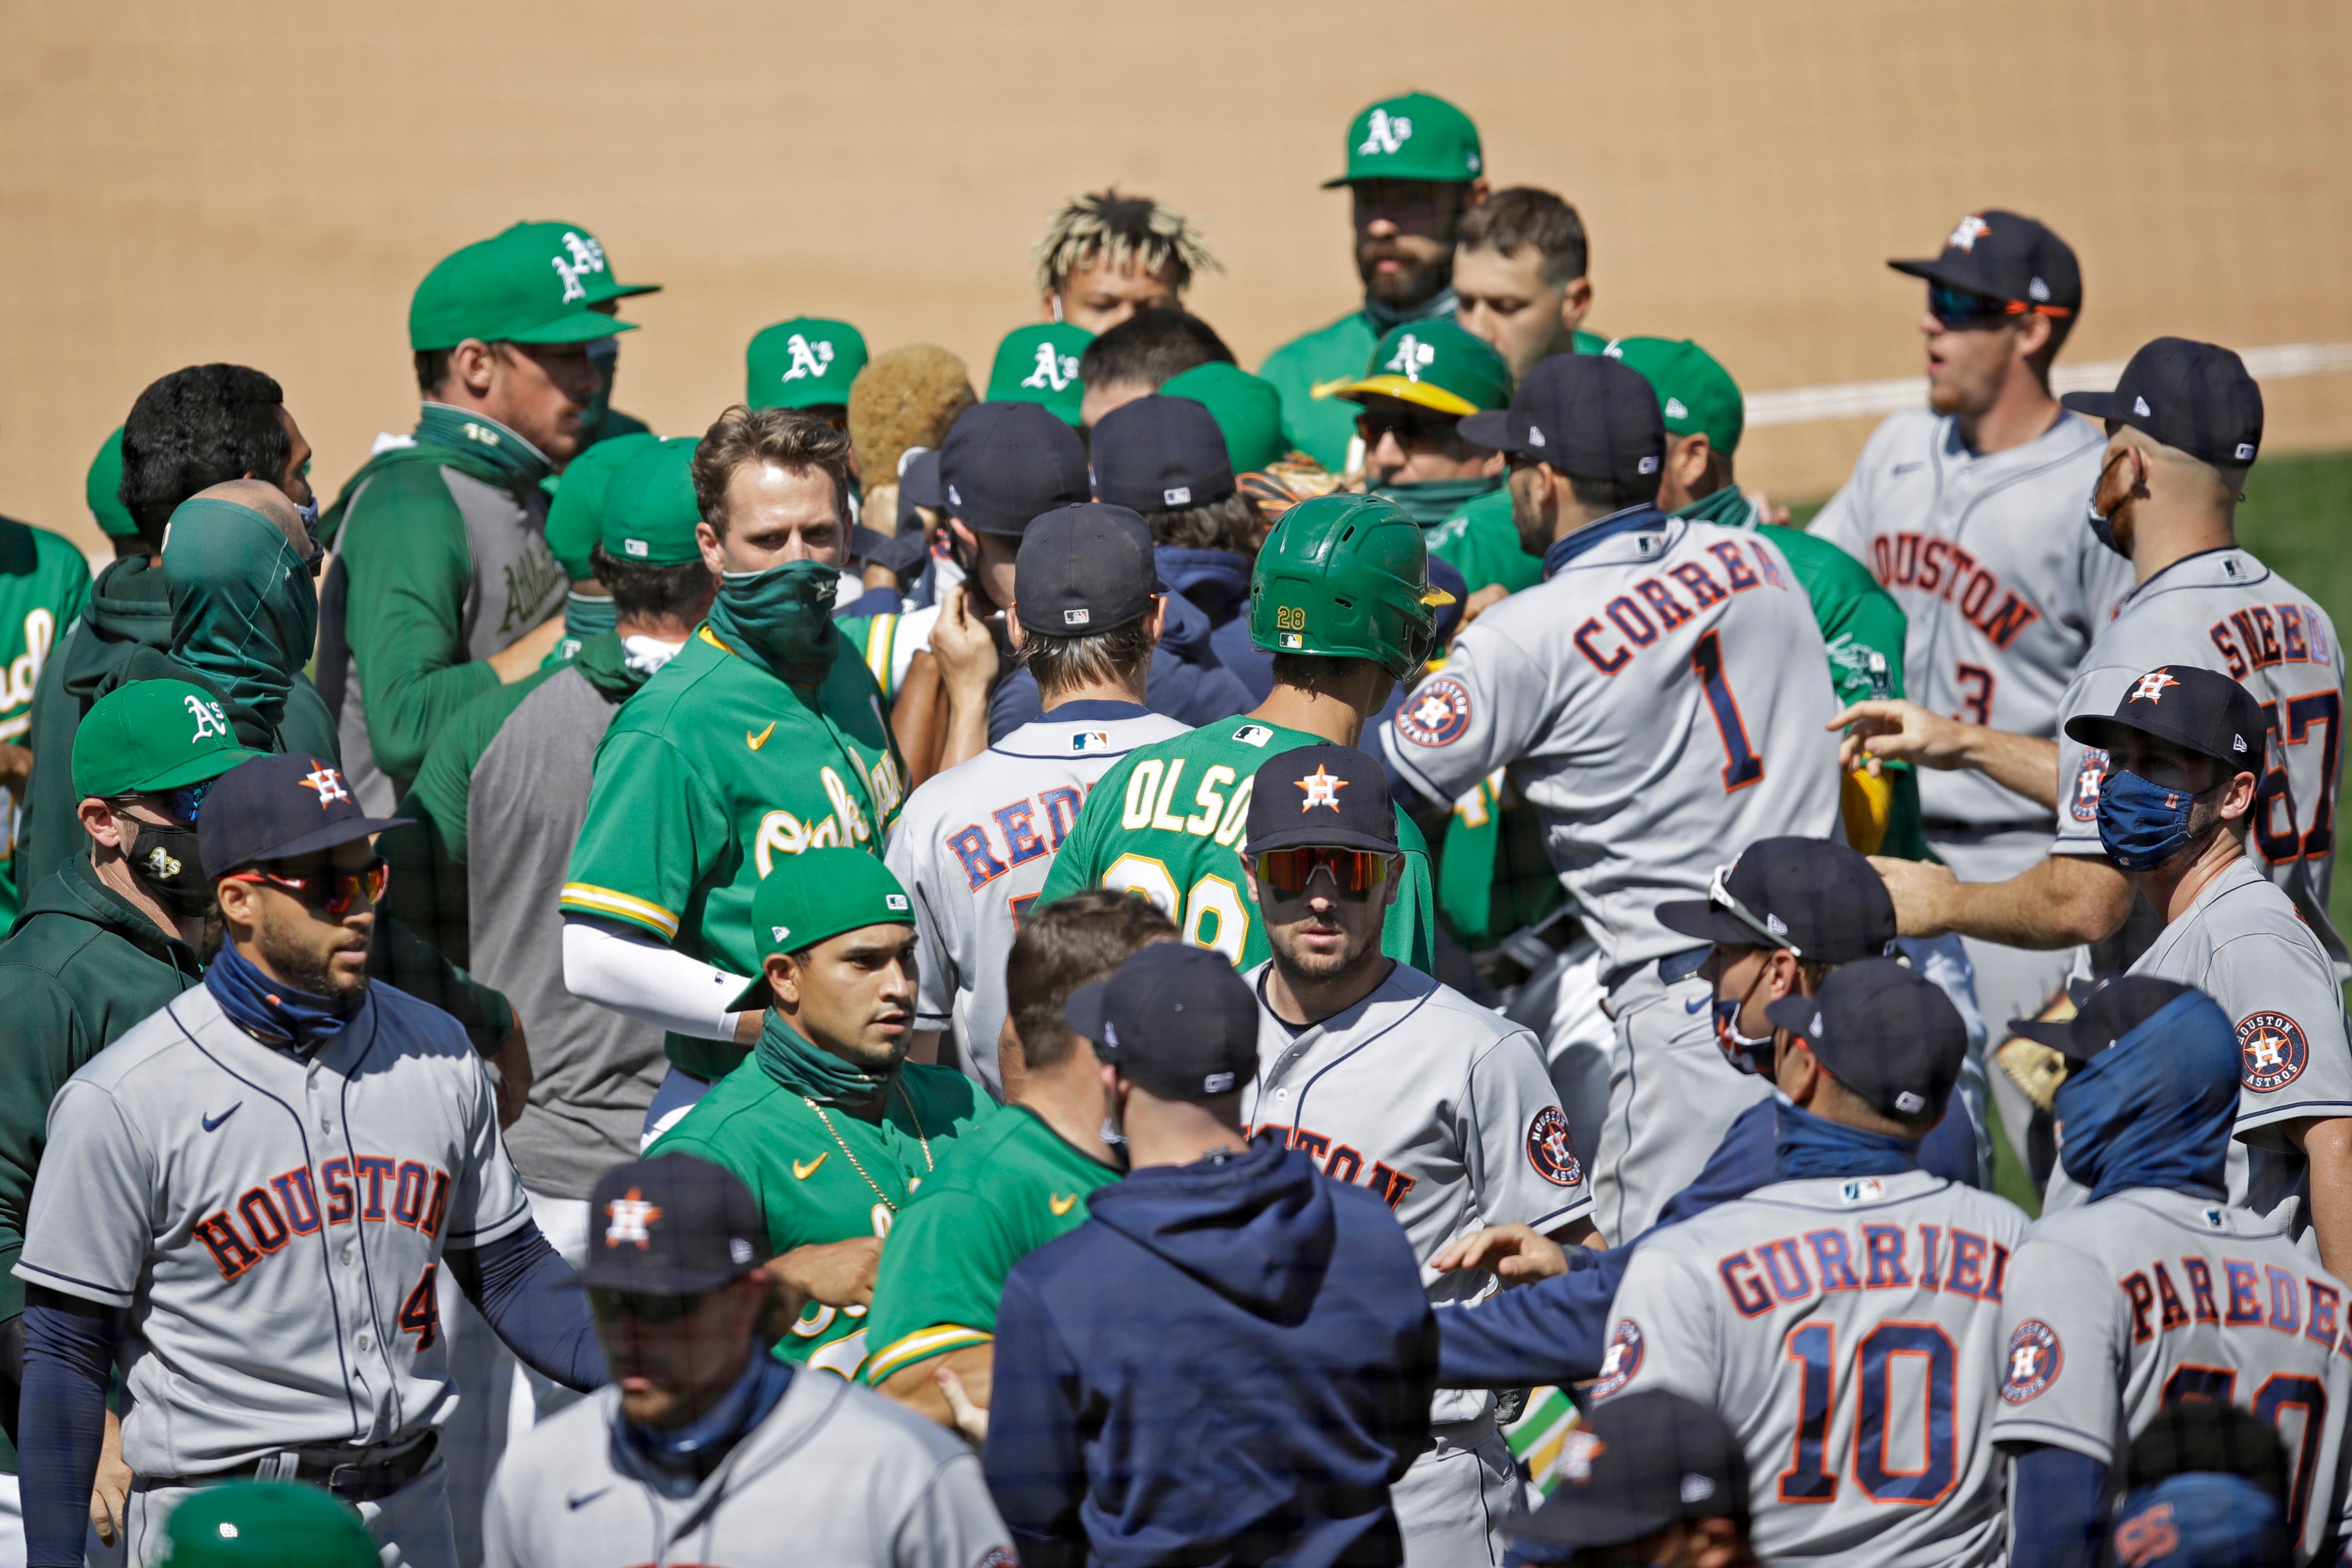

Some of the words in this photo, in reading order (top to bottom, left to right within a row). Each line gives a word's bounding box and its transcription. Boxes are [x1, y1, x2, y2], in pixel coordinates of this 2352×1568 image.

[781, 333, 835, 383] A's
[1021, 342, 1080, 392] A's
[1277, 605, 1305, 631] 28
[1574, 539, 1788, 675] CORREA
[2210, 603, 2331, 682] SNEED
[184, 695, 226, 744] A's
[1694, 629, 1765, 793] 1
[1122, 758, 1255, 854] OLSO
[2164, 793, 2179, 809] 11
[2253, 689, 2342, 866] 67
[141, 847, 182, 879] A's
[946, 782, 1097, 893] RED
[2236, 1016, 2294, 1046] HOUSTON
[2246, 1063, 2298, 1087] ASTROS
[1531, 1111, 1566, 1142] HOUSTON
[193, 1154, 451, 1282] HOUSTON
[398, 1264, 441, 1353] 4
[1778, 1319, 1958, 1506] 10
